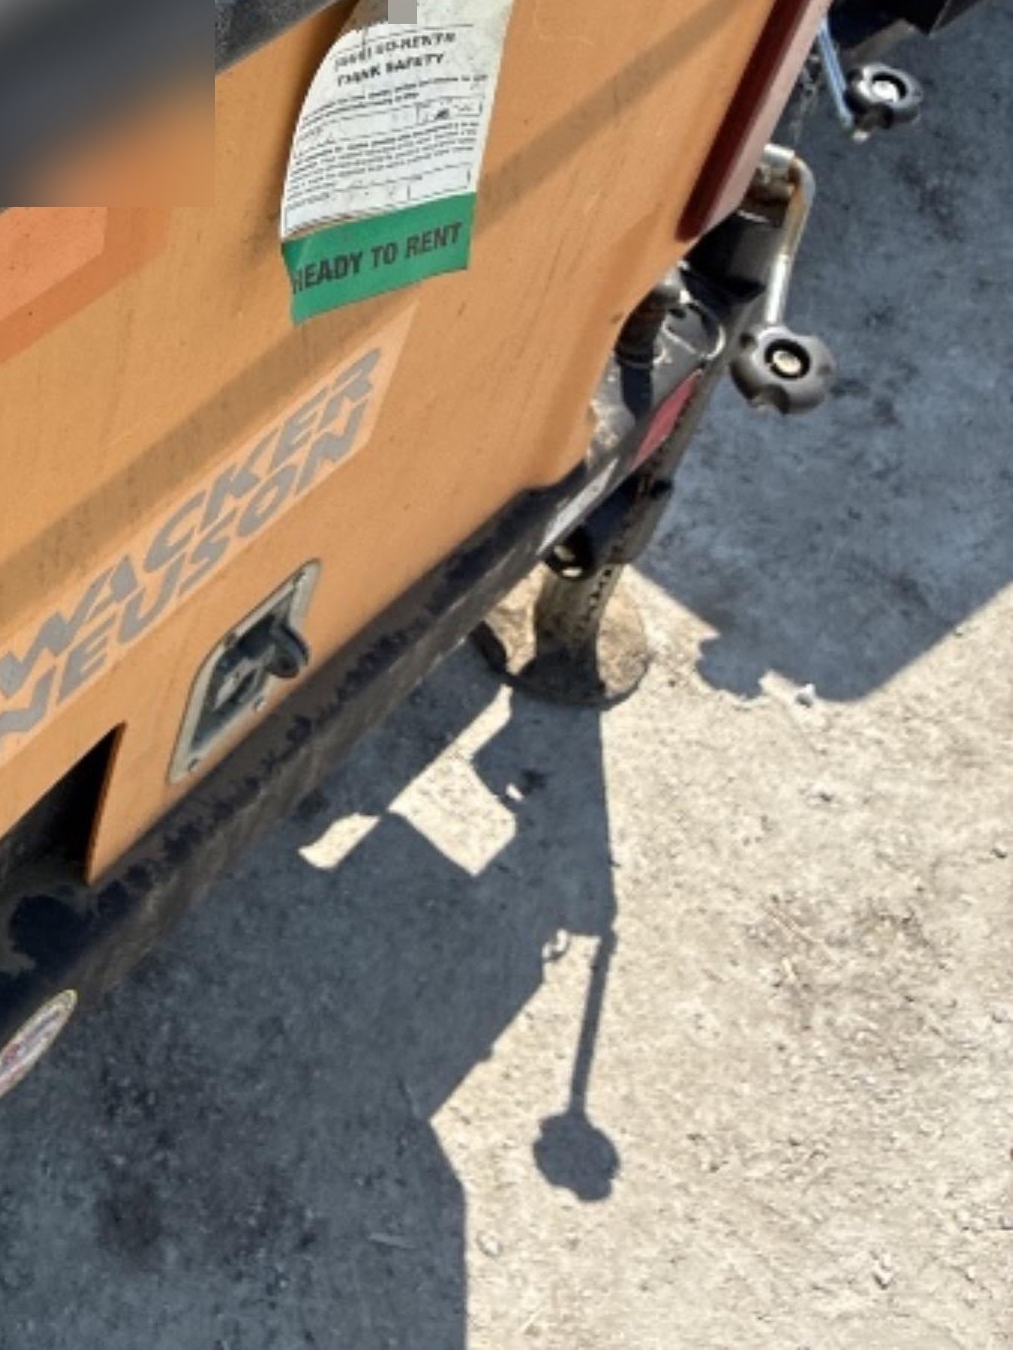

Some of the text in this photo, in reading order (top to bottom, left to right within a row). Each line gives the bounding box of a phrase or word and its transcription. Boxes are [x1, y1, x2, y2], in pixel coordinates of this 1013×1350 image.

[386, 53, 444, 73] SAFETY
[370, 242, 399, 268] TO
[405, 222, 463, 259] RENT
